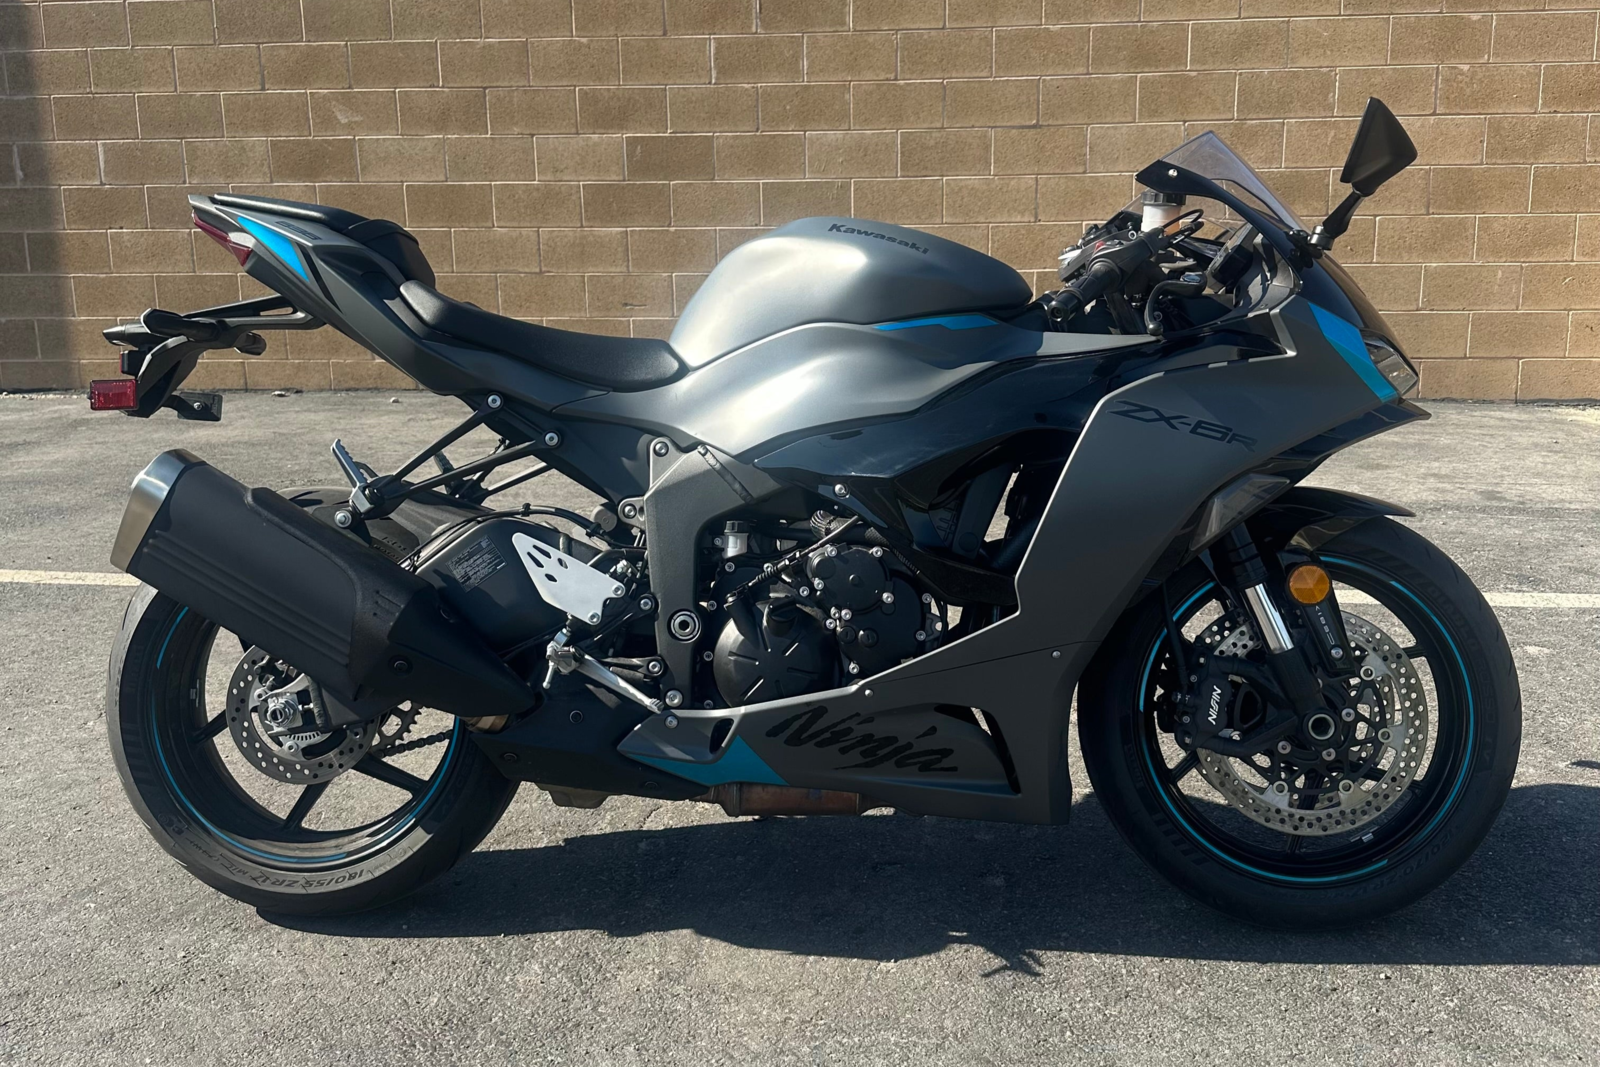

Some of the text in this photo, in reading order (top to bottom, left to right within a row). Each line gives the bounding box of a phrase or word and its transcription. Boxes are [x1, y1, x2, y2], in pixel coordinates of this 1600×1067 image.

[828, 223, 929, 254] Kawasaki
[1106, 399, 1258, 452] ZX-6R
[1207, 685, 1222, 725] NISSIN
[765, 705, 958, 772] Ninja
[303, 868, 367, 889] 180/55
